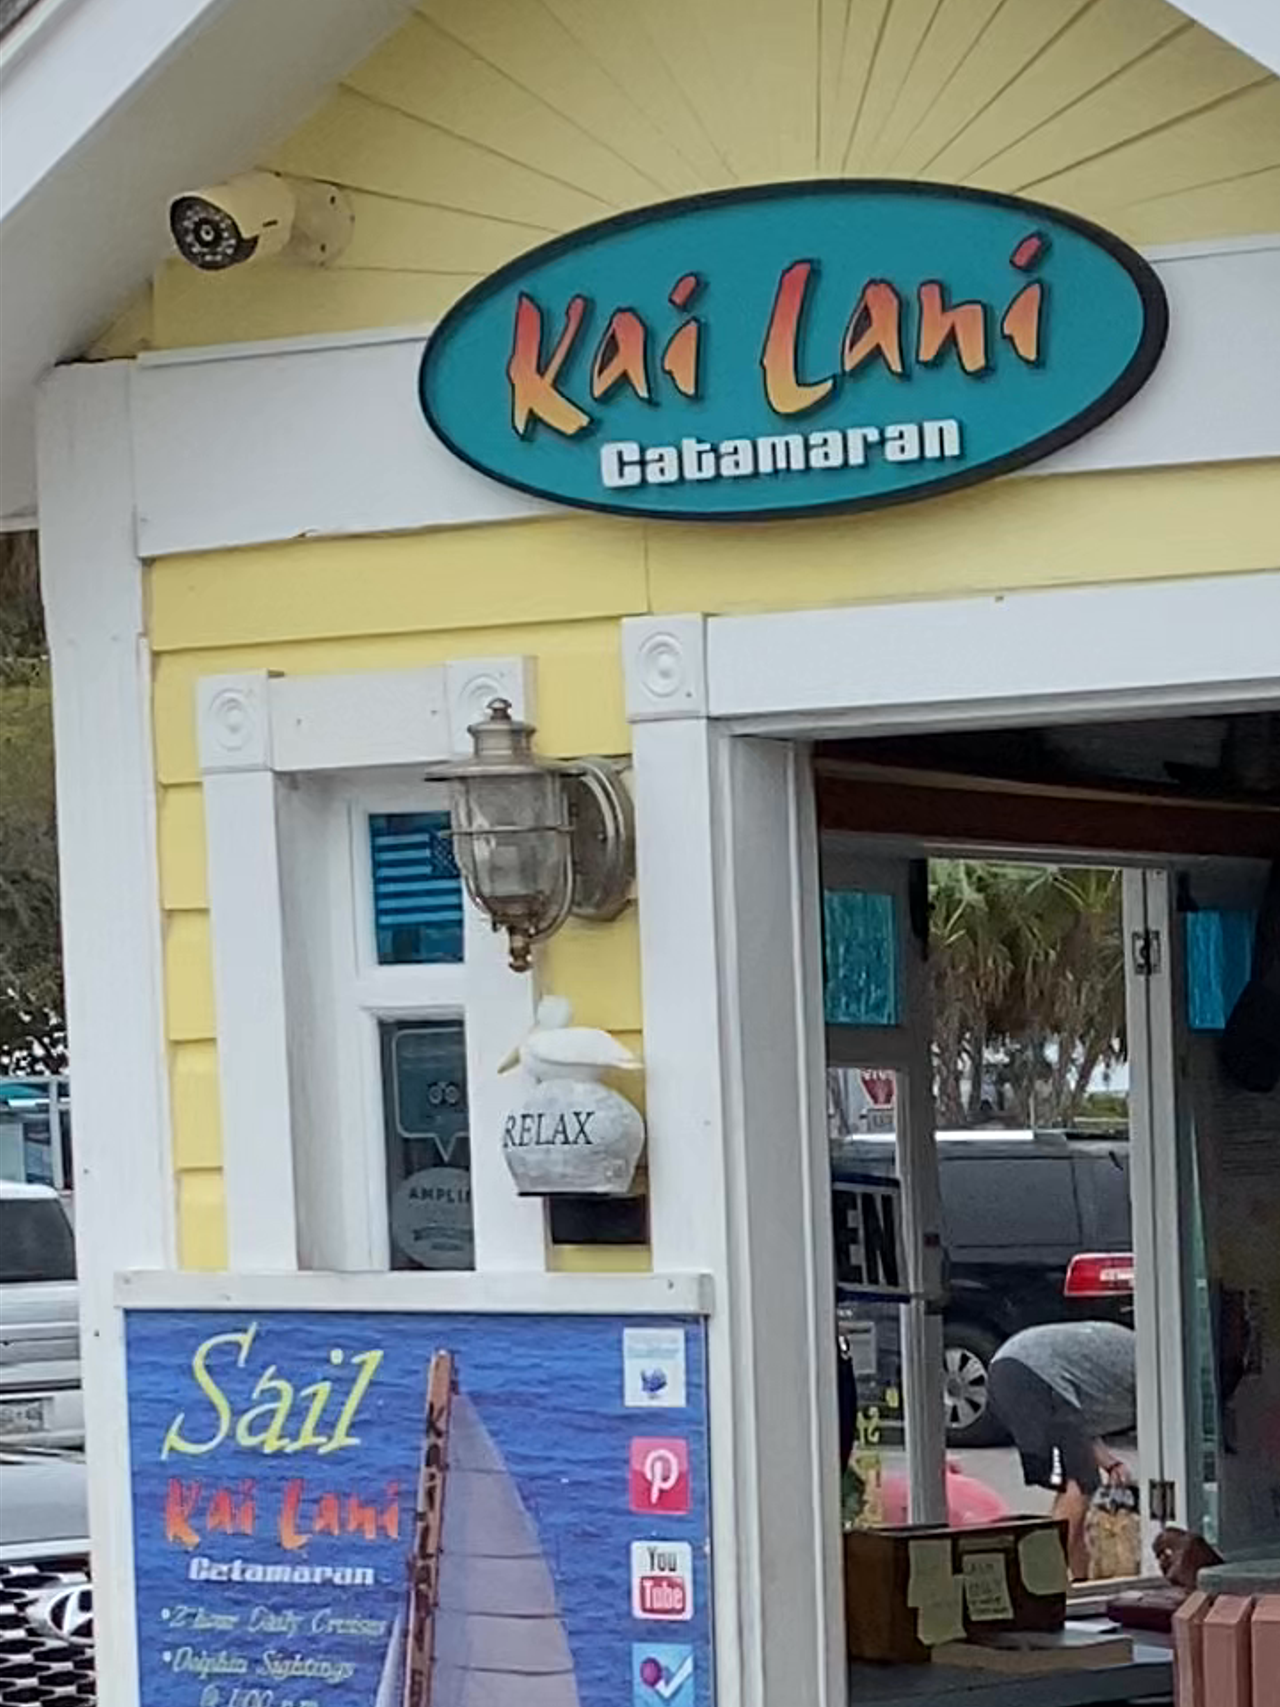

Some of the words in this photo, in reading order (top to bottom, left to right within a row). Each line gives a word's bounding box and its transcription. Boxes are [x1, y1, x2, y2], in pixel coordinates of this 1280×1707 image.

[506, 270, 710, 443] Kai
[757, 228, 1055, 419] Lani
[598, 416, 964, 490] Catamaran
[503, 1110, 595, 1148] RELAX
[159, 1320, 385, 1462] Sail
[165, 1477, 257, 1551] Kai
[278, 1477, 399, 1551] Lani
[188, 1556, 376, 1586] Catamaran
[647, 1545, 679, 1573] You
[642, 1578, 684, 1611] Tube
